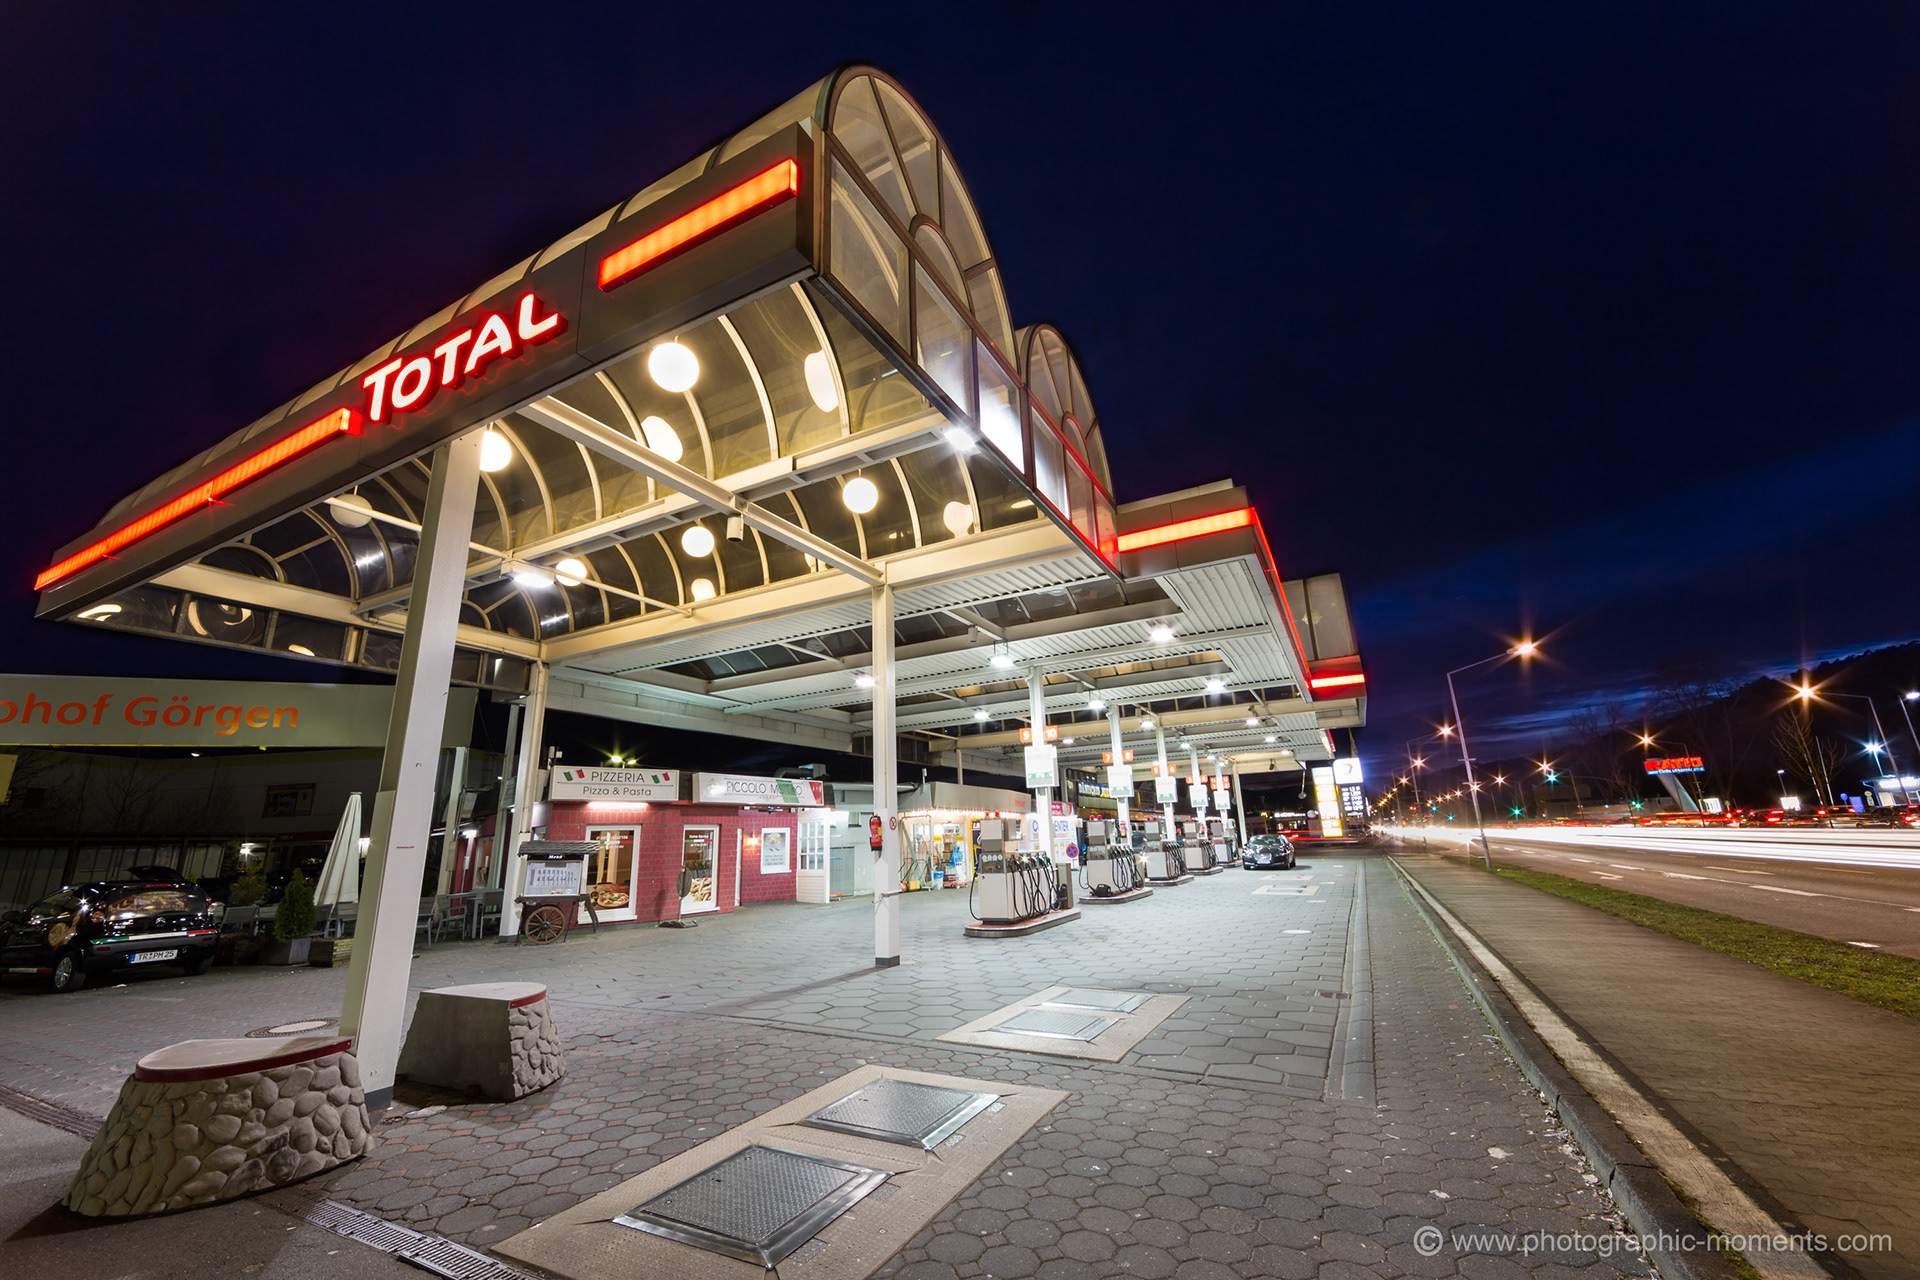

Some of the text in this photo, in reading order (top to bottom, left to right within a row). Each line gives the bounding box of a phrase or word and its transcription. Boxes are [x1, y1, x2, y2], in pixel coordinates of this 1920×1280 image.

[363, 293, 559, 421] TOTAL
[124, 695, 299, 736] Görgen
[1022, 730, 1030, 740] 9
[1045, 728, 1056, 739] 10
[1105, 753, 1111, 762] 7
[1645, 757, 1703, 771] RATIO
[591, 771, 645, 783] PIZZERIA
[582, 786, 652, 796] Pizza & Pasta
[726, 781, 803, 796] PICCOLO MONDO
[138, 953, 149, 961] TR
